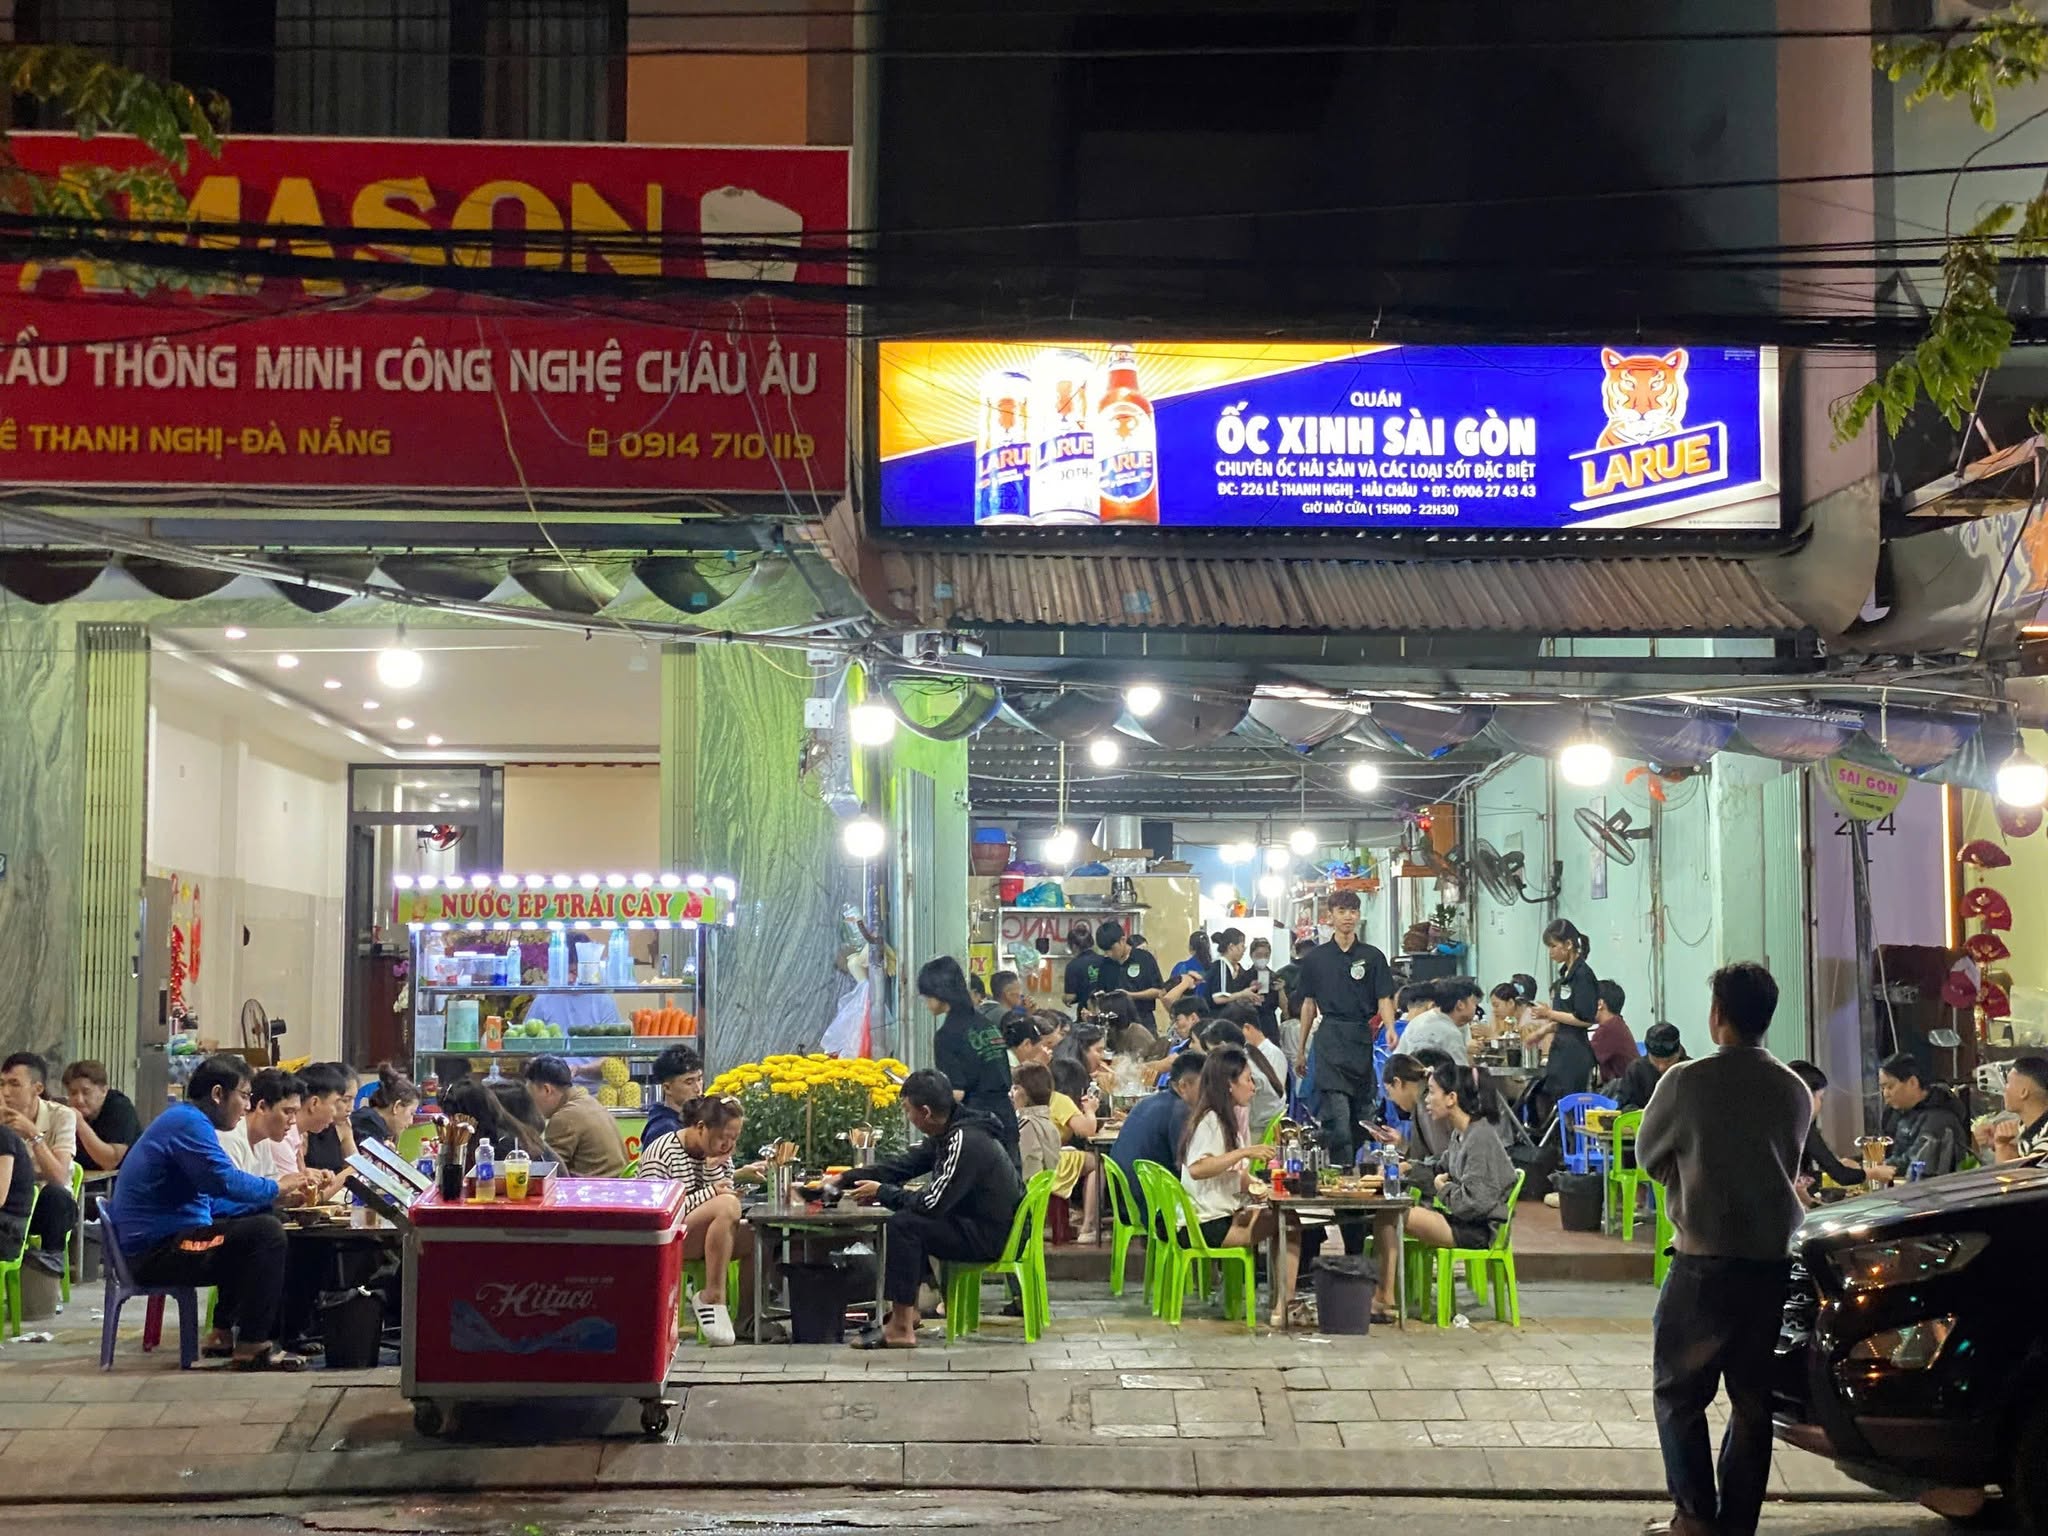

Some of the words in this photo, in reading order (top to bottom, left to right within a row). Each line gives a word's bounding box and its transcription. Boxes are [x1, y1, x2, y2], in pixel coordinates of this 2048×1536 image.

[86, 337, 237, 389] THÔNG
[256, 346, 363, 390] MINH
[375, 336, 493, 393] CÔNG
[510, 338, 623, 402] NGHỆ
[635, 339, 746, 395] CHÂU
[758, 339, 817, 395] ÂU
[1350, 390, 1402, 408] QUÁN
[28, 424, 139, 453] THANH
[1215, 401, 1271, 455] ỐC
[1277, 416, 1375, 456] XINH
[1382, 408, 1446, 457] SÀI
[1454, 408, 1536, 457] GÒN
[619, 432, 699, 459] 0914
[711, 433, 765, 460] 710
[774, 433, 815, 461] 119
[1101, 451, 1152, 476] LARUE
[1215, 459, 1273, 477] CHUYÊN
[1275, 457, 1296, 477] ỐC
[1299, 458, 1325, 477] HẢI
[1327, 458, 1355, 478] SẢN
[1357, 459, 1379, 478] VÀ
[1380, 460, 1408, 479] CÁC
[1410, 462, 1443, 483] LOẠI
[1445, 459, 1472, 479] SỐT
[1473, 460, 1504, 483] ĐẶC
[1506, 460, 1537, 483] BIỆT
[1581, 433, 1713, 498] LARUE
[1241, 483, 1265, 497] 226
[1266, 480, 1280, 497] LÊ
[1281, 483, 1322, 497] THANH
[1323, 483, 1354, 499] NGHỊ
[1361, 481, 1384, 498] HẢI
[1385, 481, 1418, 498] CHÂU
[1452, 484, 1484, 498] 0906
[1485, 484, 1502, 498] 27
[1503, 484, 1519, 498] 43
[1520, 484, 1537, 498] 43
[1302, 501, 1323, 514] GIỜ
[1324, 500, 1344, 514] MỞ
[1376, 503, 1412, 516] 15H00
[441, 887, 511, 918] NƯỚC
[517, 887, 548, 918] ÉP
[553, 886, 616, 918] TRÁI
[621, 887, 673, 918] CÂY
[476, 1281, 597, 1317] Hitaco
